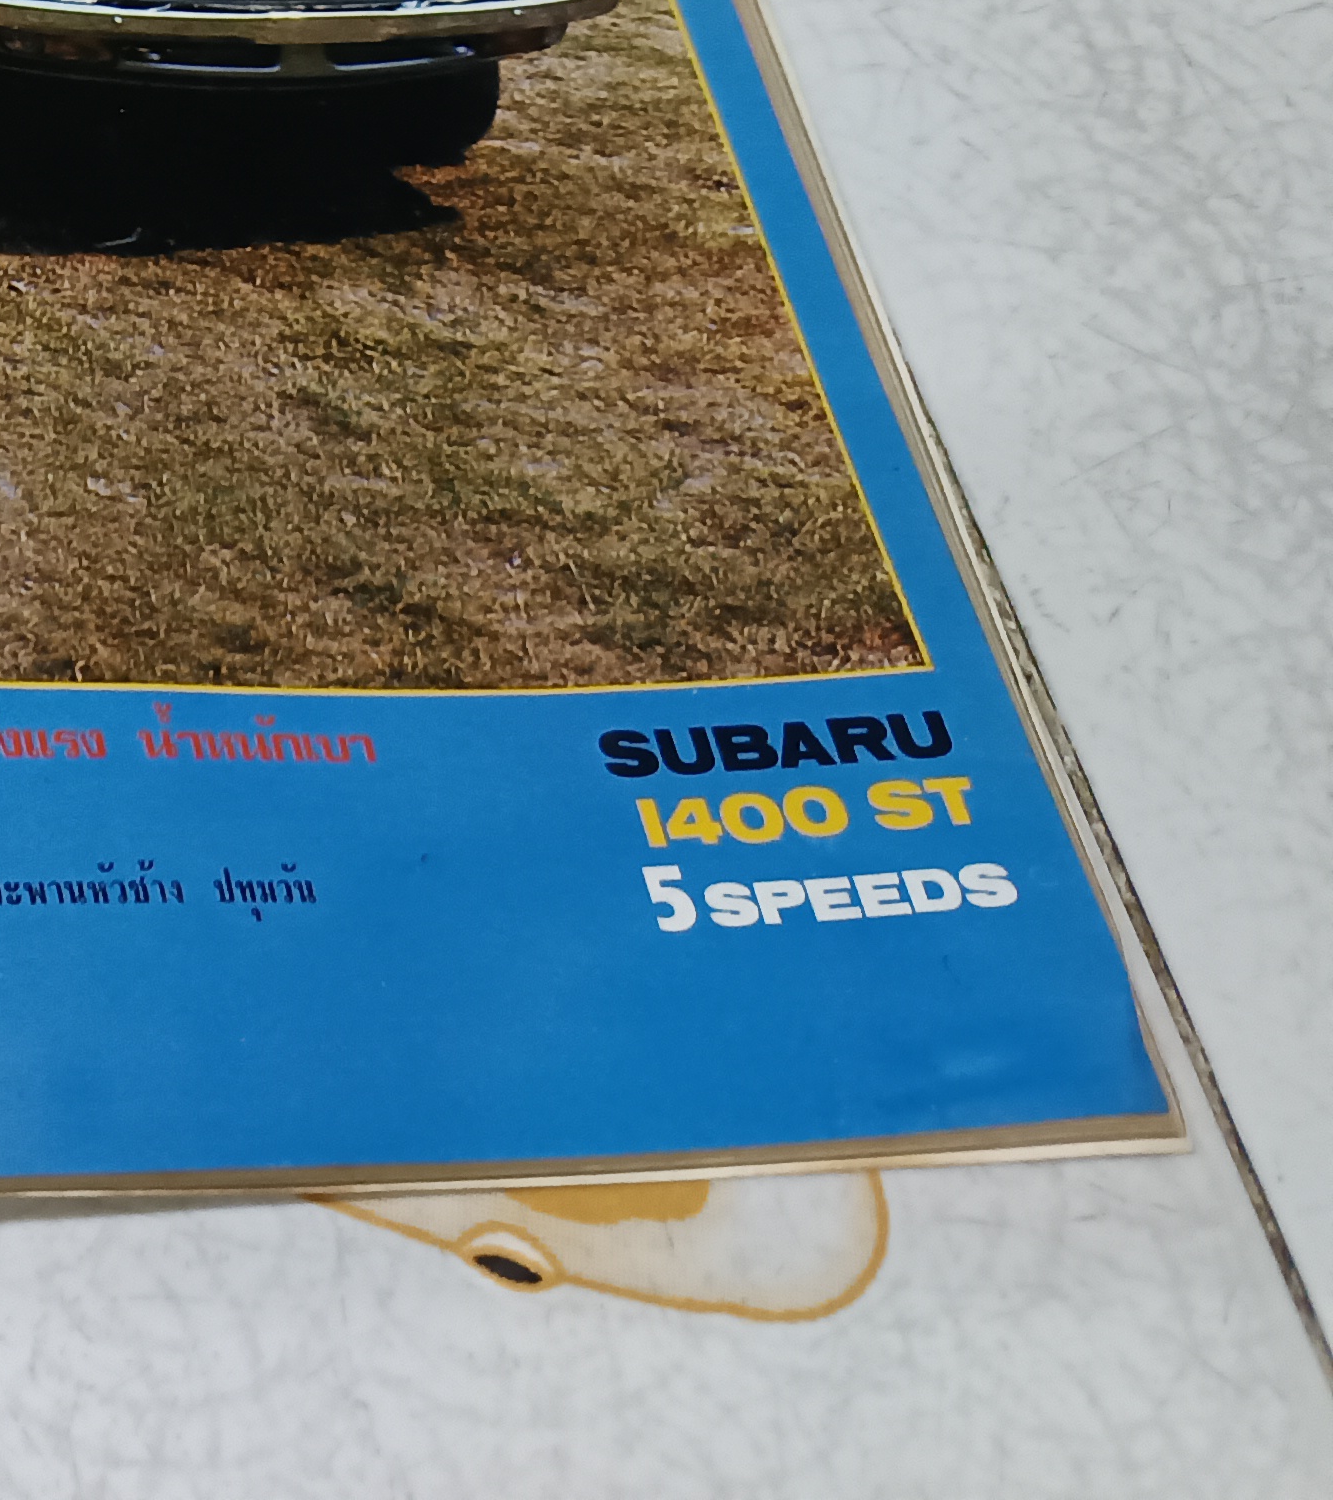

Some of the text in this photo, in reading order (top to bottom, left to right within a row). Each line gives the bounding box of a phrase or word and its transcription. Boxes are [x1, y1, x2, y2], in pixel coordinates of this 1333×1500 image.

[138, 701, 377, 764] น้ำหนักเบา
[598, 710, 954, 778] SUBARU
[635, 776, 972, 849] 1400 ST
[213, 861, 317, 923] ปทุมวัน
[641, 862, 1019, 933] 5 SPEEDS
